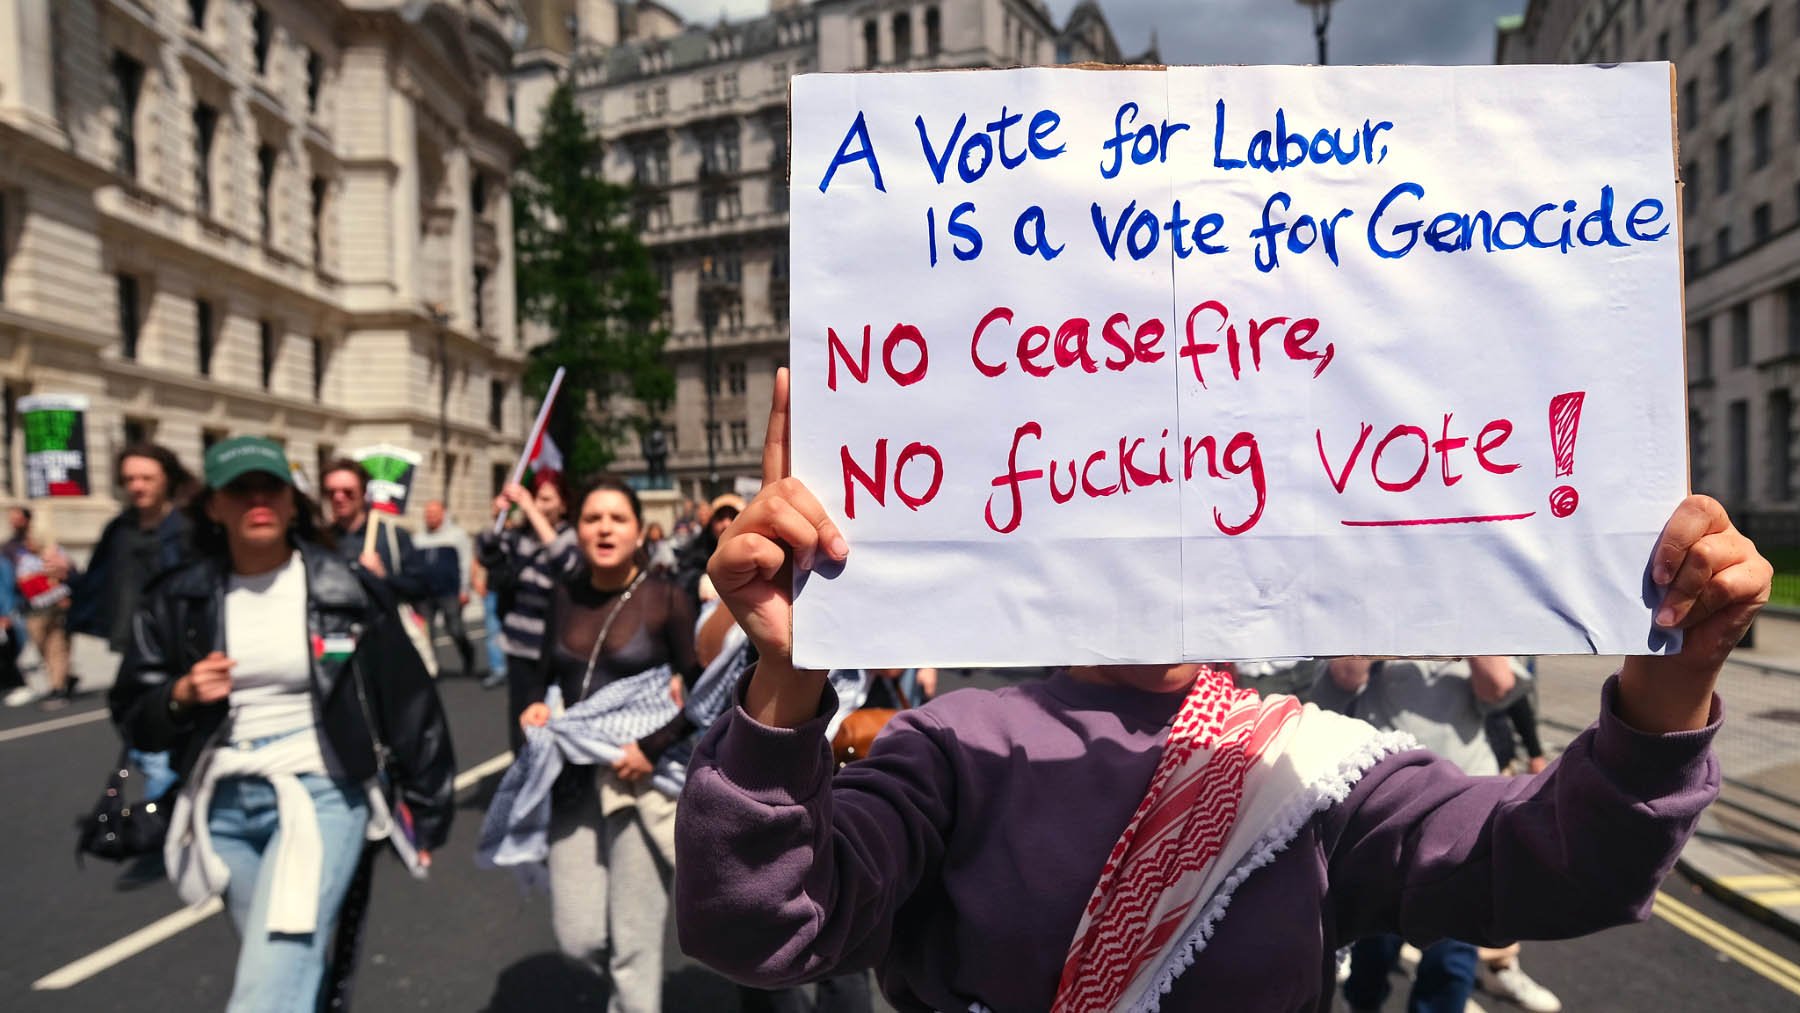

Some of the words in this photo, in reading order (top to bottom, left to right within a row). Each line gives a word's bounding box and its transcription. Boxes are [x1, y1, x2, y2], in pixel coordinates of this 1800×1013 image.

[819, 111, 886, 192] A
[1101, 102, 1190, 178] for
[1214, 99, 1393, 173] Labour,
[1014, 206, 1065, 260] a
[1250, 192, 1353, 272] for
[1368, 182, 1669, 258] Genocide
